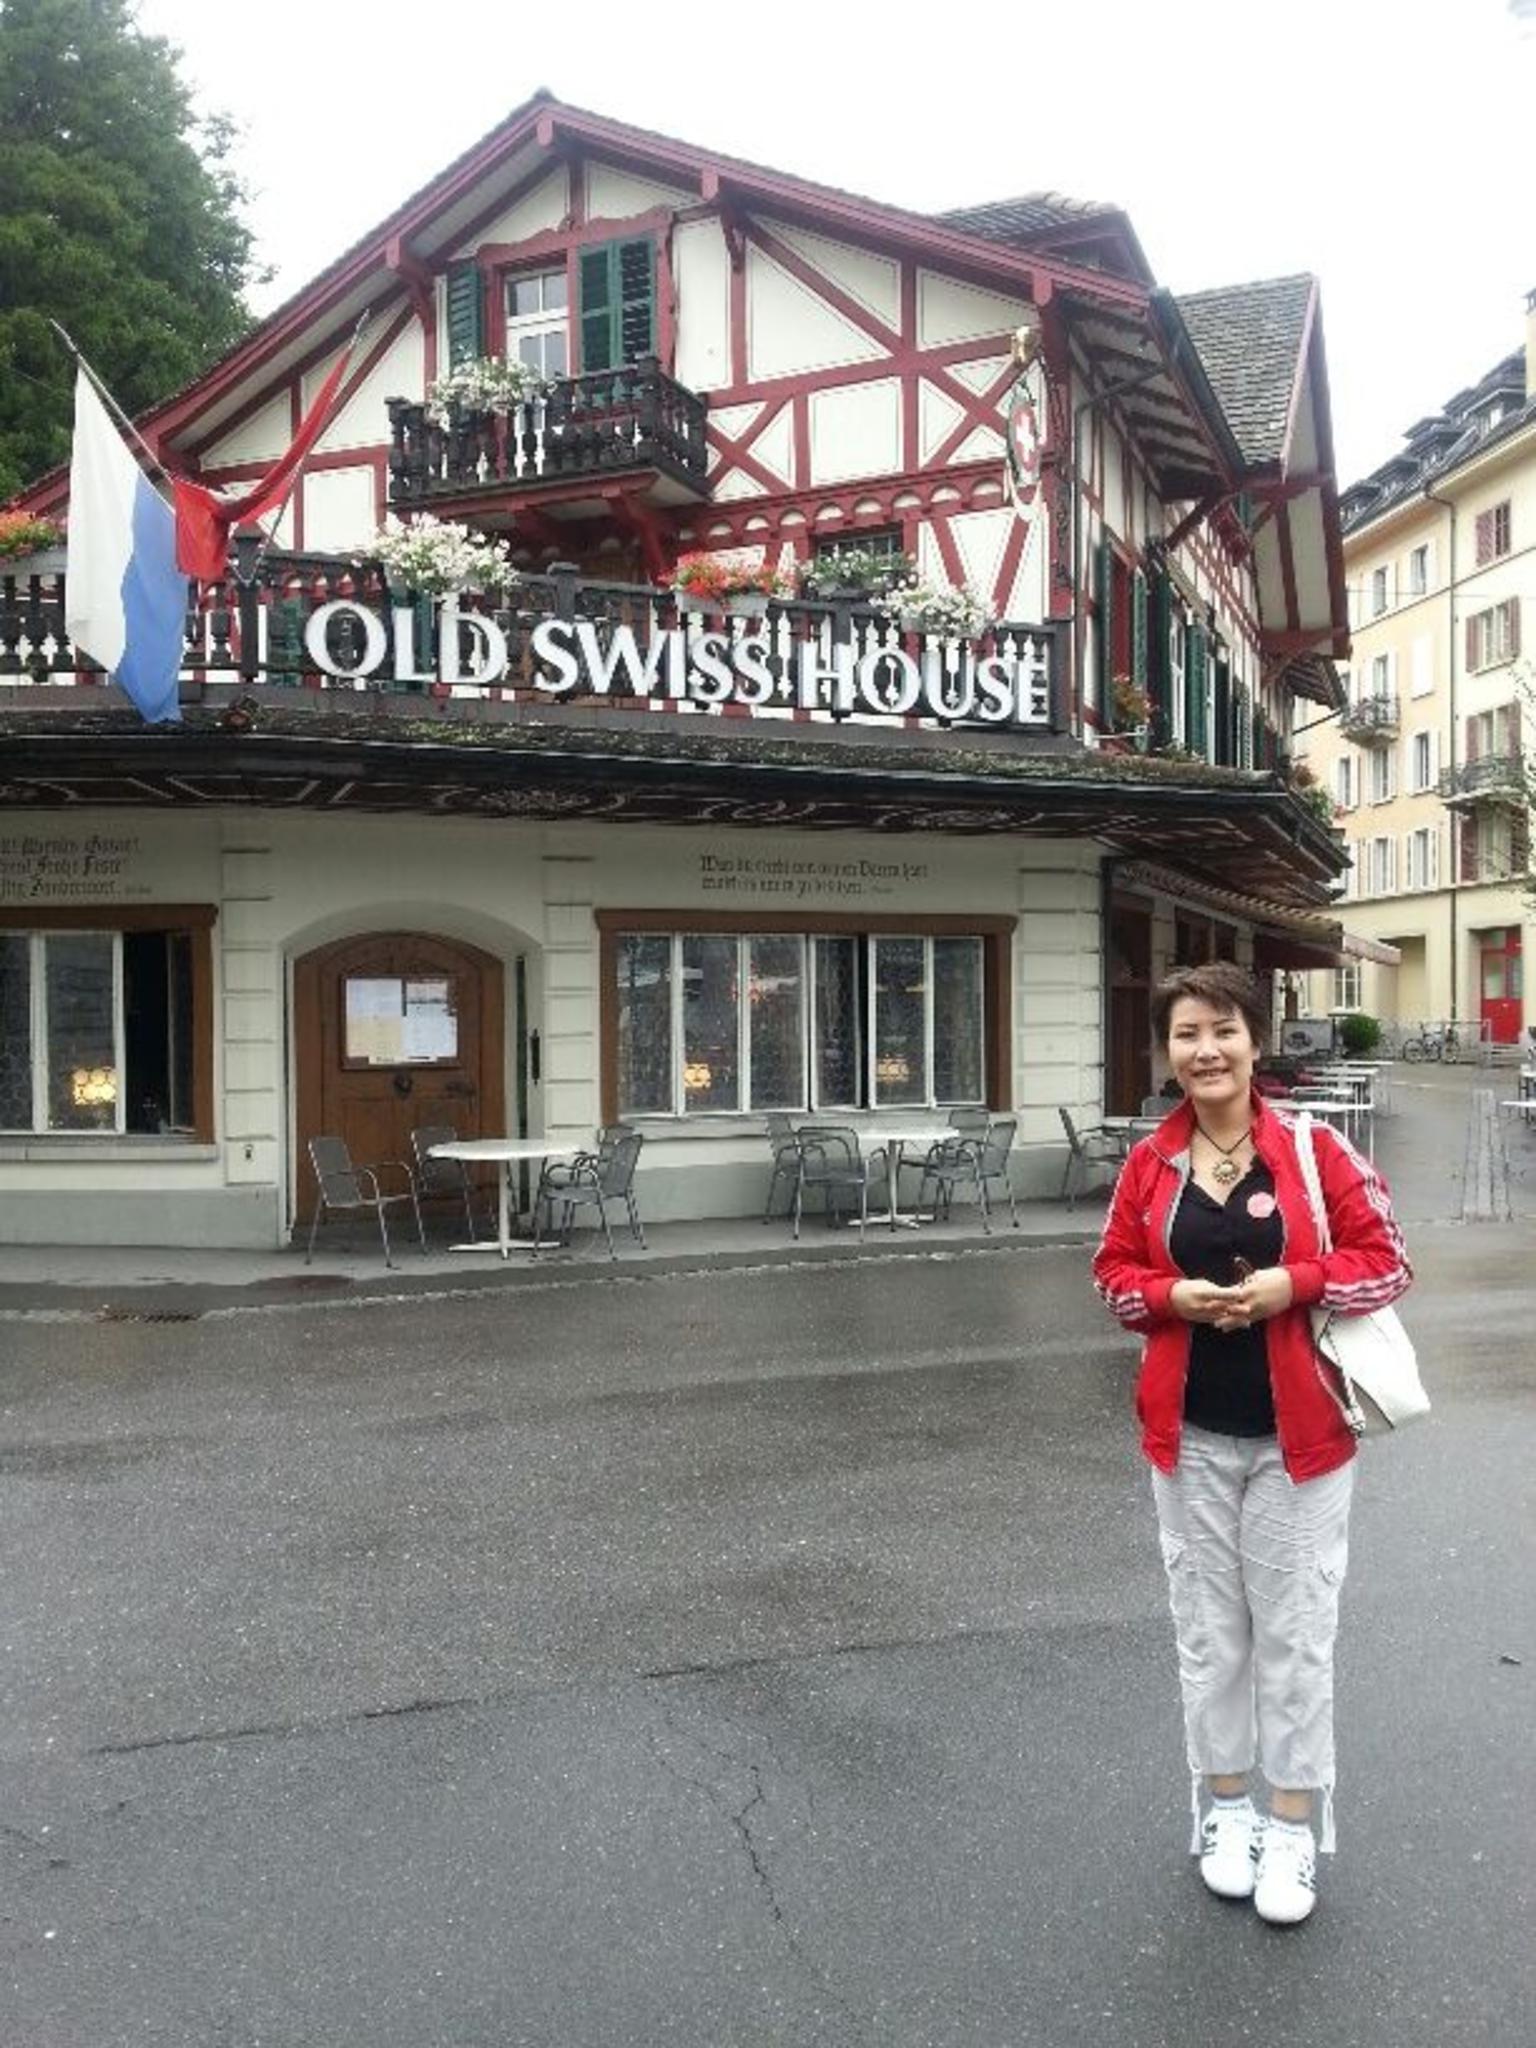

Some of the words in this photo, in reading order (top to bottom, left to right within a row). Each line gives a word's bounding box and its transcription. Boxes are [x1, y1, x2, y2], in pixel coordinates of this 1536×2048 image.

[304, 599, 507, 685] OLD
[531, 619, 774, 705] SWISS
[799, 641, 1050, 724] HOUSE
